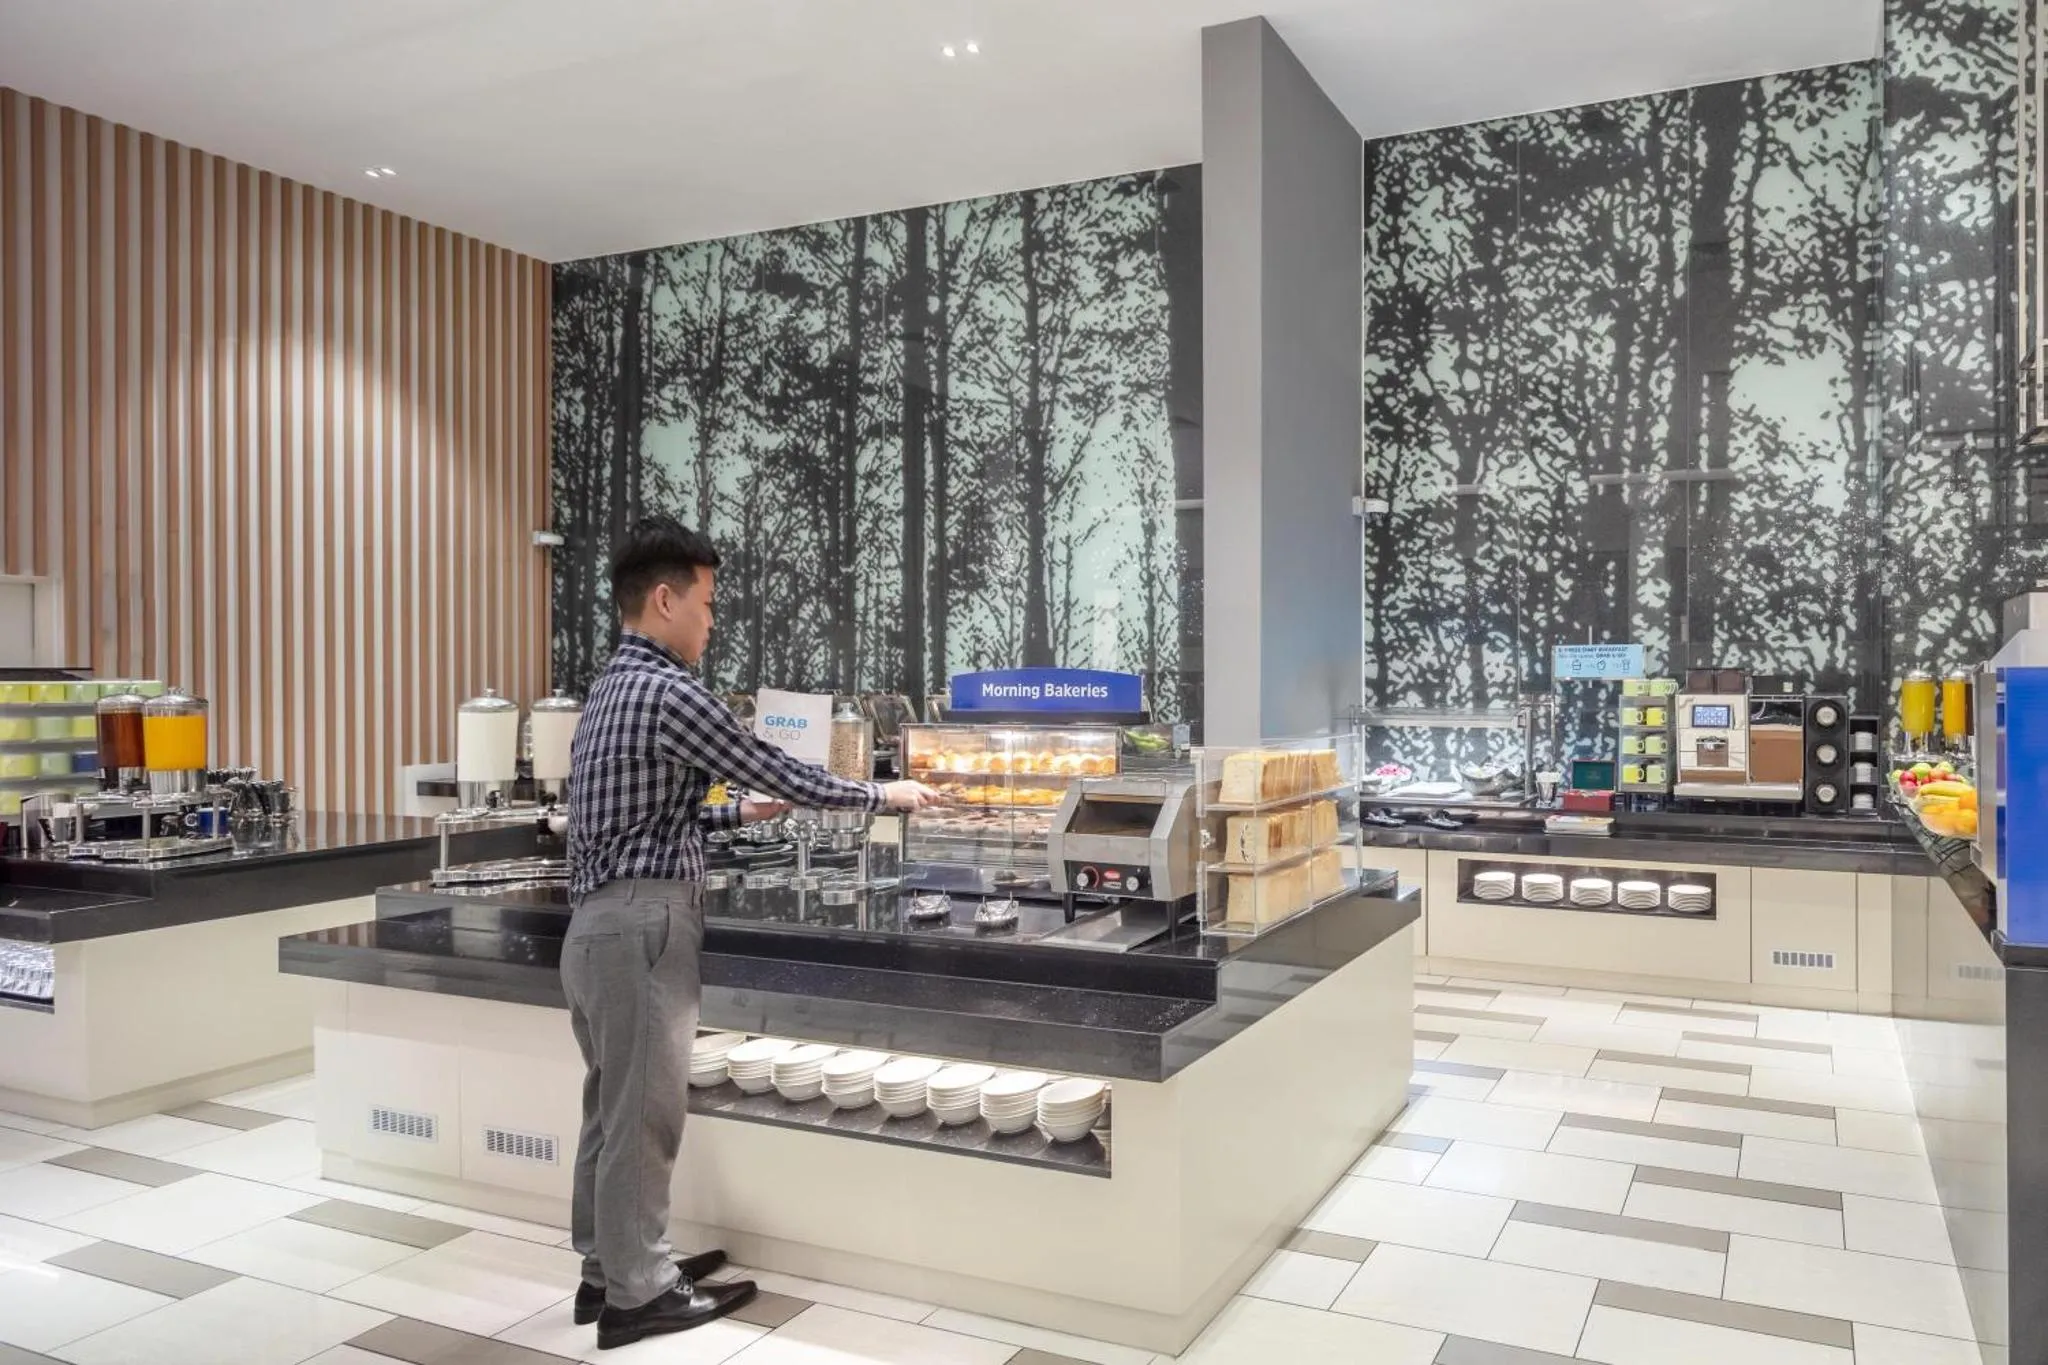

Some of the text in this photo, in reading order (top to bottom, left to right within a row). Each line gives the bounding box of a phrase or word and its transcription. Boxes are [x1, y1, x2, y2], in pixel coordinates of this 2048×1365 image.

[982, 683, 1108, 699] Morning Bakeries
[765, 716, 808, 729] GRAB
[763, 728, 801, 741] & GO
